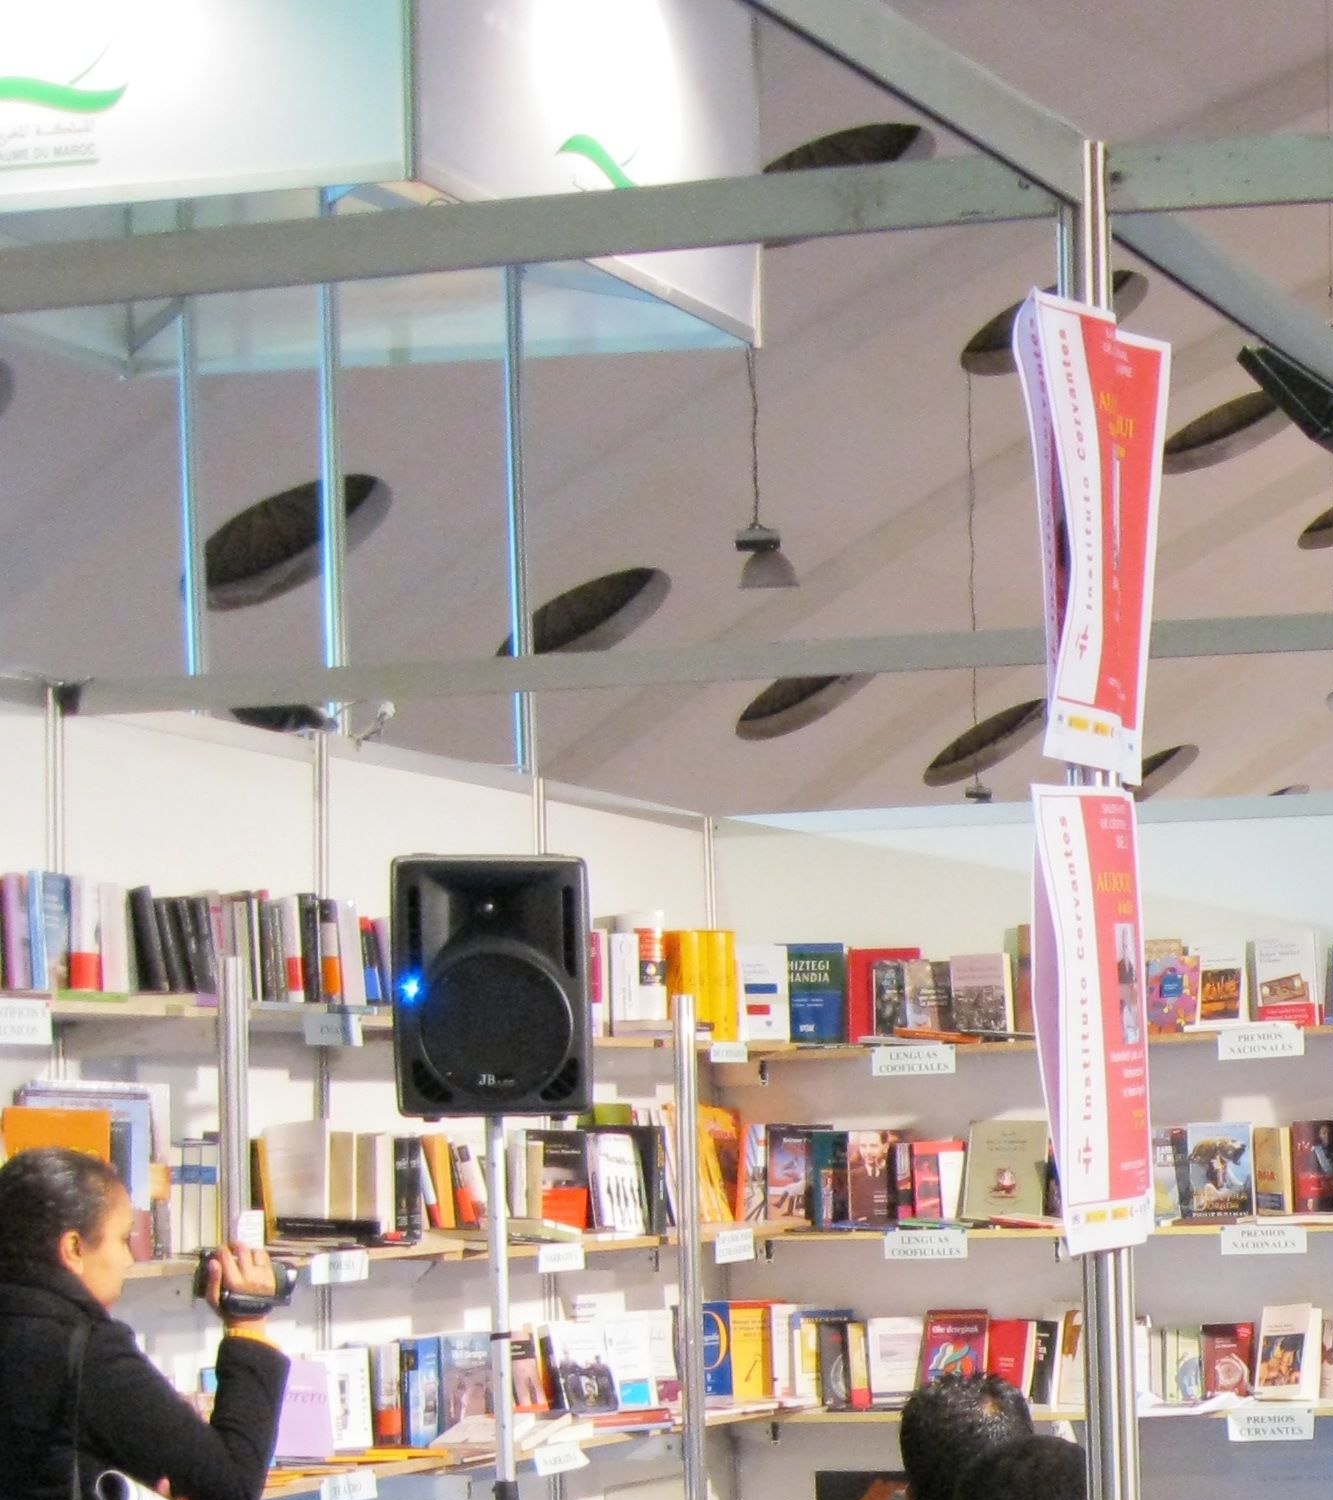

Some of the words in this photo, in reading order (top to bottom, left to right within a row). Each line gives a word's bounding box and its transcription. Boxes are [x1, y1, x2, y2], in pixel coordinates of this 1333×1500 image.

[1238, 1032, 1283, 1044] PREMIOS
[888, 1050, 938, 1062] LENGUAS
[879, 1062, 950, 1074] COOFICIALES
[1240, 1228, 1287, 1239] PREMIOS
[900, 1235, 950, 1246] LENGUAS
[891, 1246, 962, 1258] COOFICIALES
[1246, 1414, 1296, 1426] PREMIOS
[1239, 1425, 1305, 1437] CERVANTES
